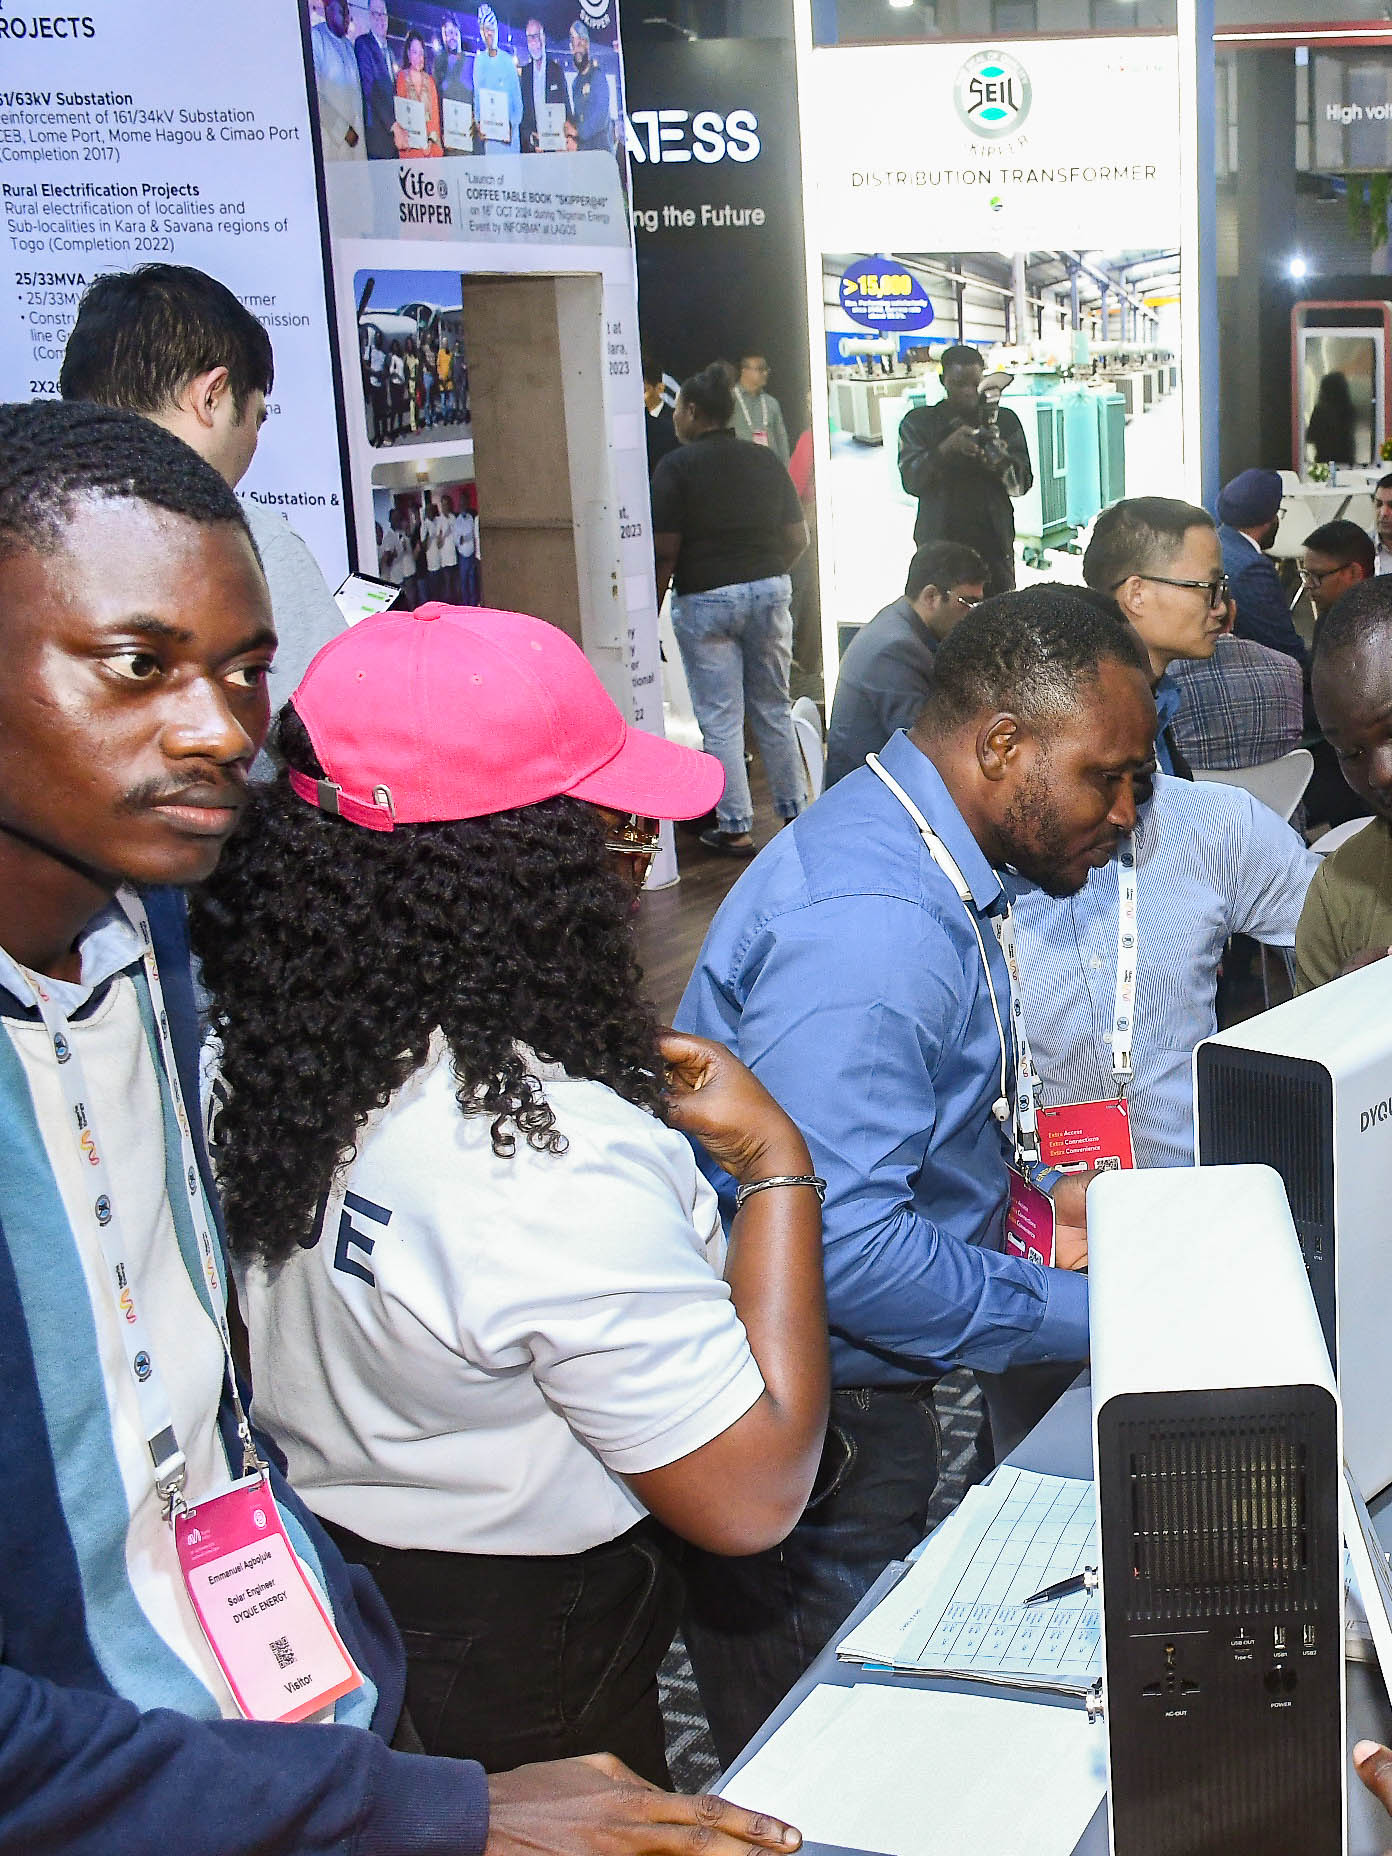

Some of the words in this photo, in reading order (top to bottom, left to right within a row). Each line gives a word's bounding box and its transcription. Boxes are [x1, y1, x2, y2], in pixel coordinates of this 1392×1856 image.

[0, 17, 95, 39] ROJECTS
[56, 91, 133, 106] Substation
[1, 111, 91, 125] einforcement
[95, 109, 109, 124] of
[113, 109, 174, 124] 161/34kV
[179, 108, 255, 123] Substation
[29, 129, 67, 143] Lome
[72, 128, 104, 144] Port,
[108, 128, 151, 142] Mome
[156, 127, 202, 145] Hagou
[206, 127, 216, 141] &
[220, 126, 264, 141] Cimao
[269, 125, 300, 141] Port
[0, 147, 80, 164] (Completion
[84, 146, 120, 163] 2017)
[851, 168, 991, 188] DISTRIBUTION
[1001, 165, 1157, 185] TRANSFORMER
[2, 184, 38, 197] Rural
[41, 183, 138, 198] Electrification
[142, 183, 200, 199] Projects
[5, 201, 39, 215] Rural
[43, 201, 133, 215] electrification
[137, 200, 151, 215] of
[155, 201, 215, 215] localities
[219, 200, 245, 215] and
[399, 203, 453, 225] SKIPPER
[662, 205, 696, 227] the
[701, 204, 766, 226] Future
[7, 219, 95, 233] Sub-localities
[100, 219, 110, 233] in
[115, 219, 146, 233] Kara
[150, 219, 160, 233] &
[164, 219, 214, 233] Savana
[218, 219, 270, 236] regions
[274, 217, 289, 232] of
[11, 237, 45, 253] Togo
[49, 237, 130, 253] (Completion
[135, 237, 175, 253] 2022)
[30, 329, 52, 342] line
[250, 491, 325, 506] Substation
[330, 493, 340, 506] &
[208, 1563, 243, 1585] Emmanuel
[227, 1593, 246, 1607] Solar
[245, 1579, 276, 1598] Engineer
[233, 1605, 259, 1624] DYQUE
[258, 1590, 288, 1611] ENERGY
[283, 1673, 313, 1694] Visitor
